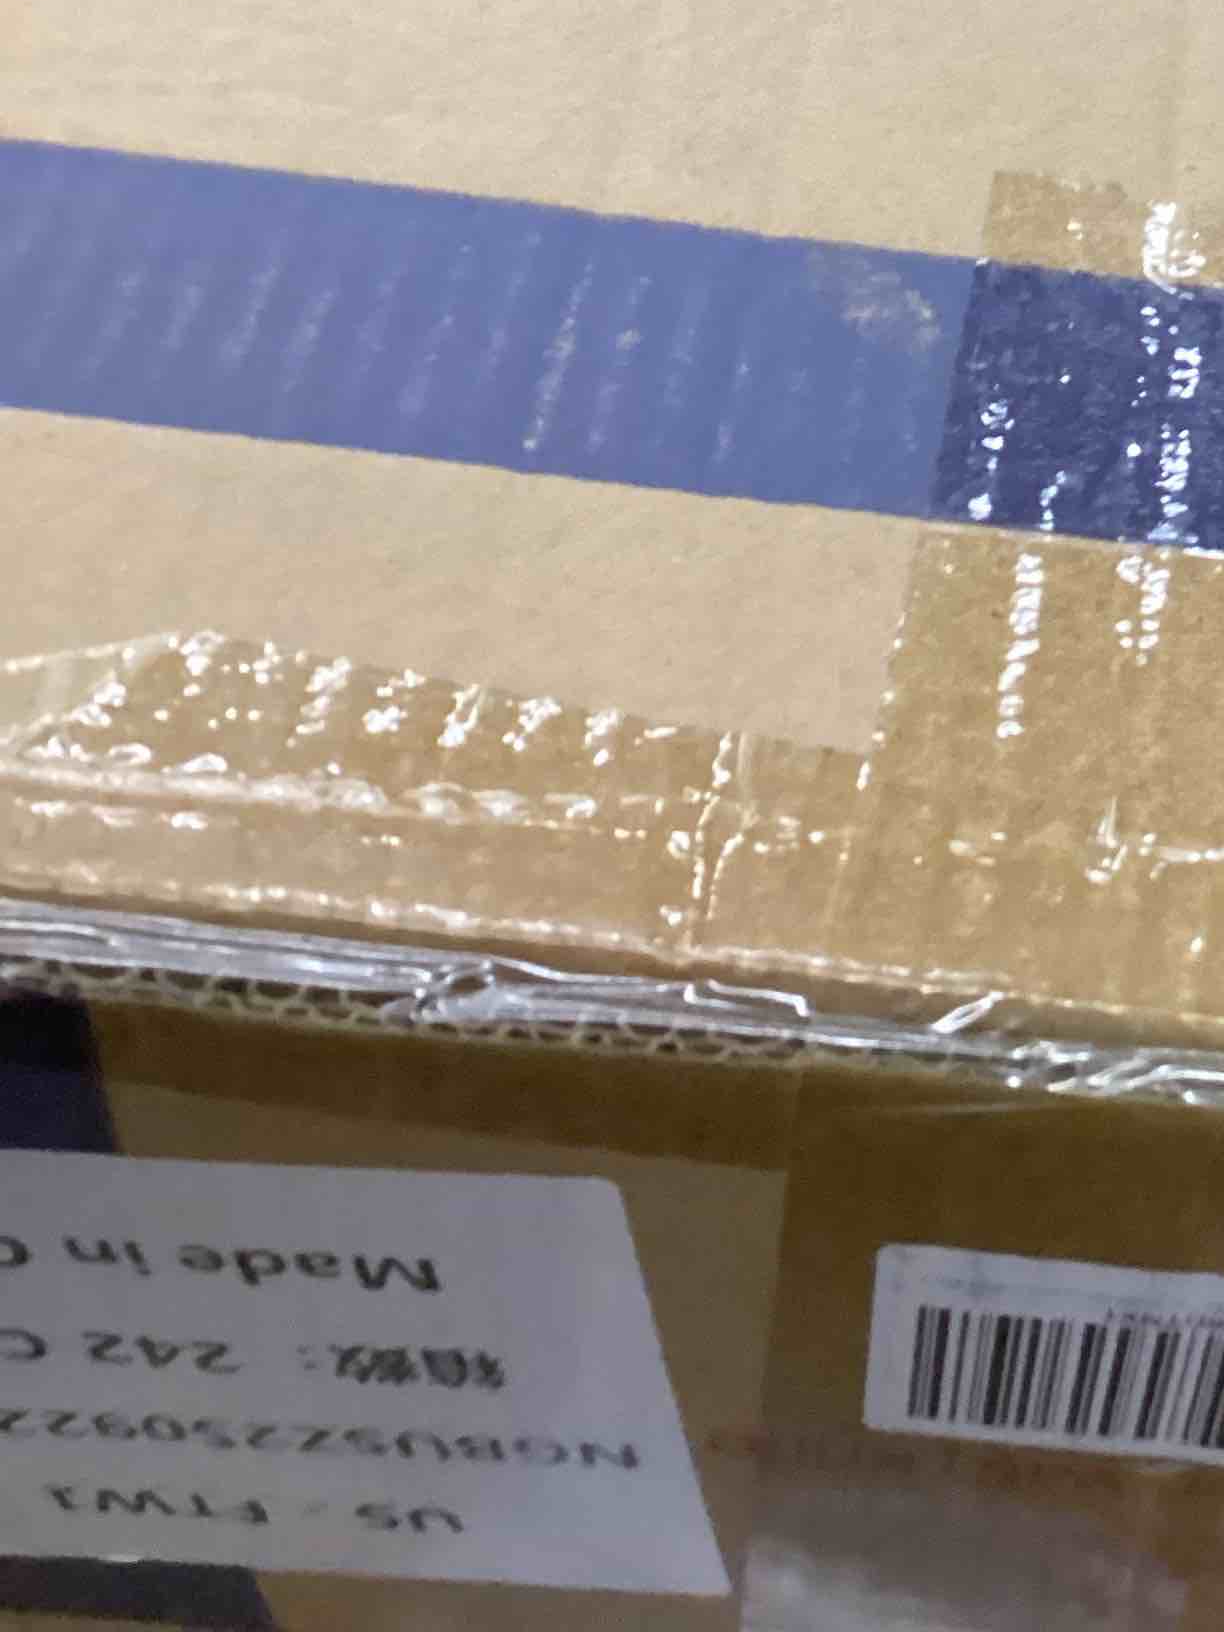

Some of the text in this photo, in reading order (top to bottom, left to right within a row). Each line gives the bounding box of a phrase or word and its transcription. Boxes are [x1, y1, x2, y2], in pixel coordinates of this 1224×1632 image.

[64, 1236, 150, 1276] in
[179, 1244, 441, 1292] Made
[82, 1330, 240, 1374] 242
[44, 1483, 270, 1526] FTW1
[355, 1502, 465, 1534] US
